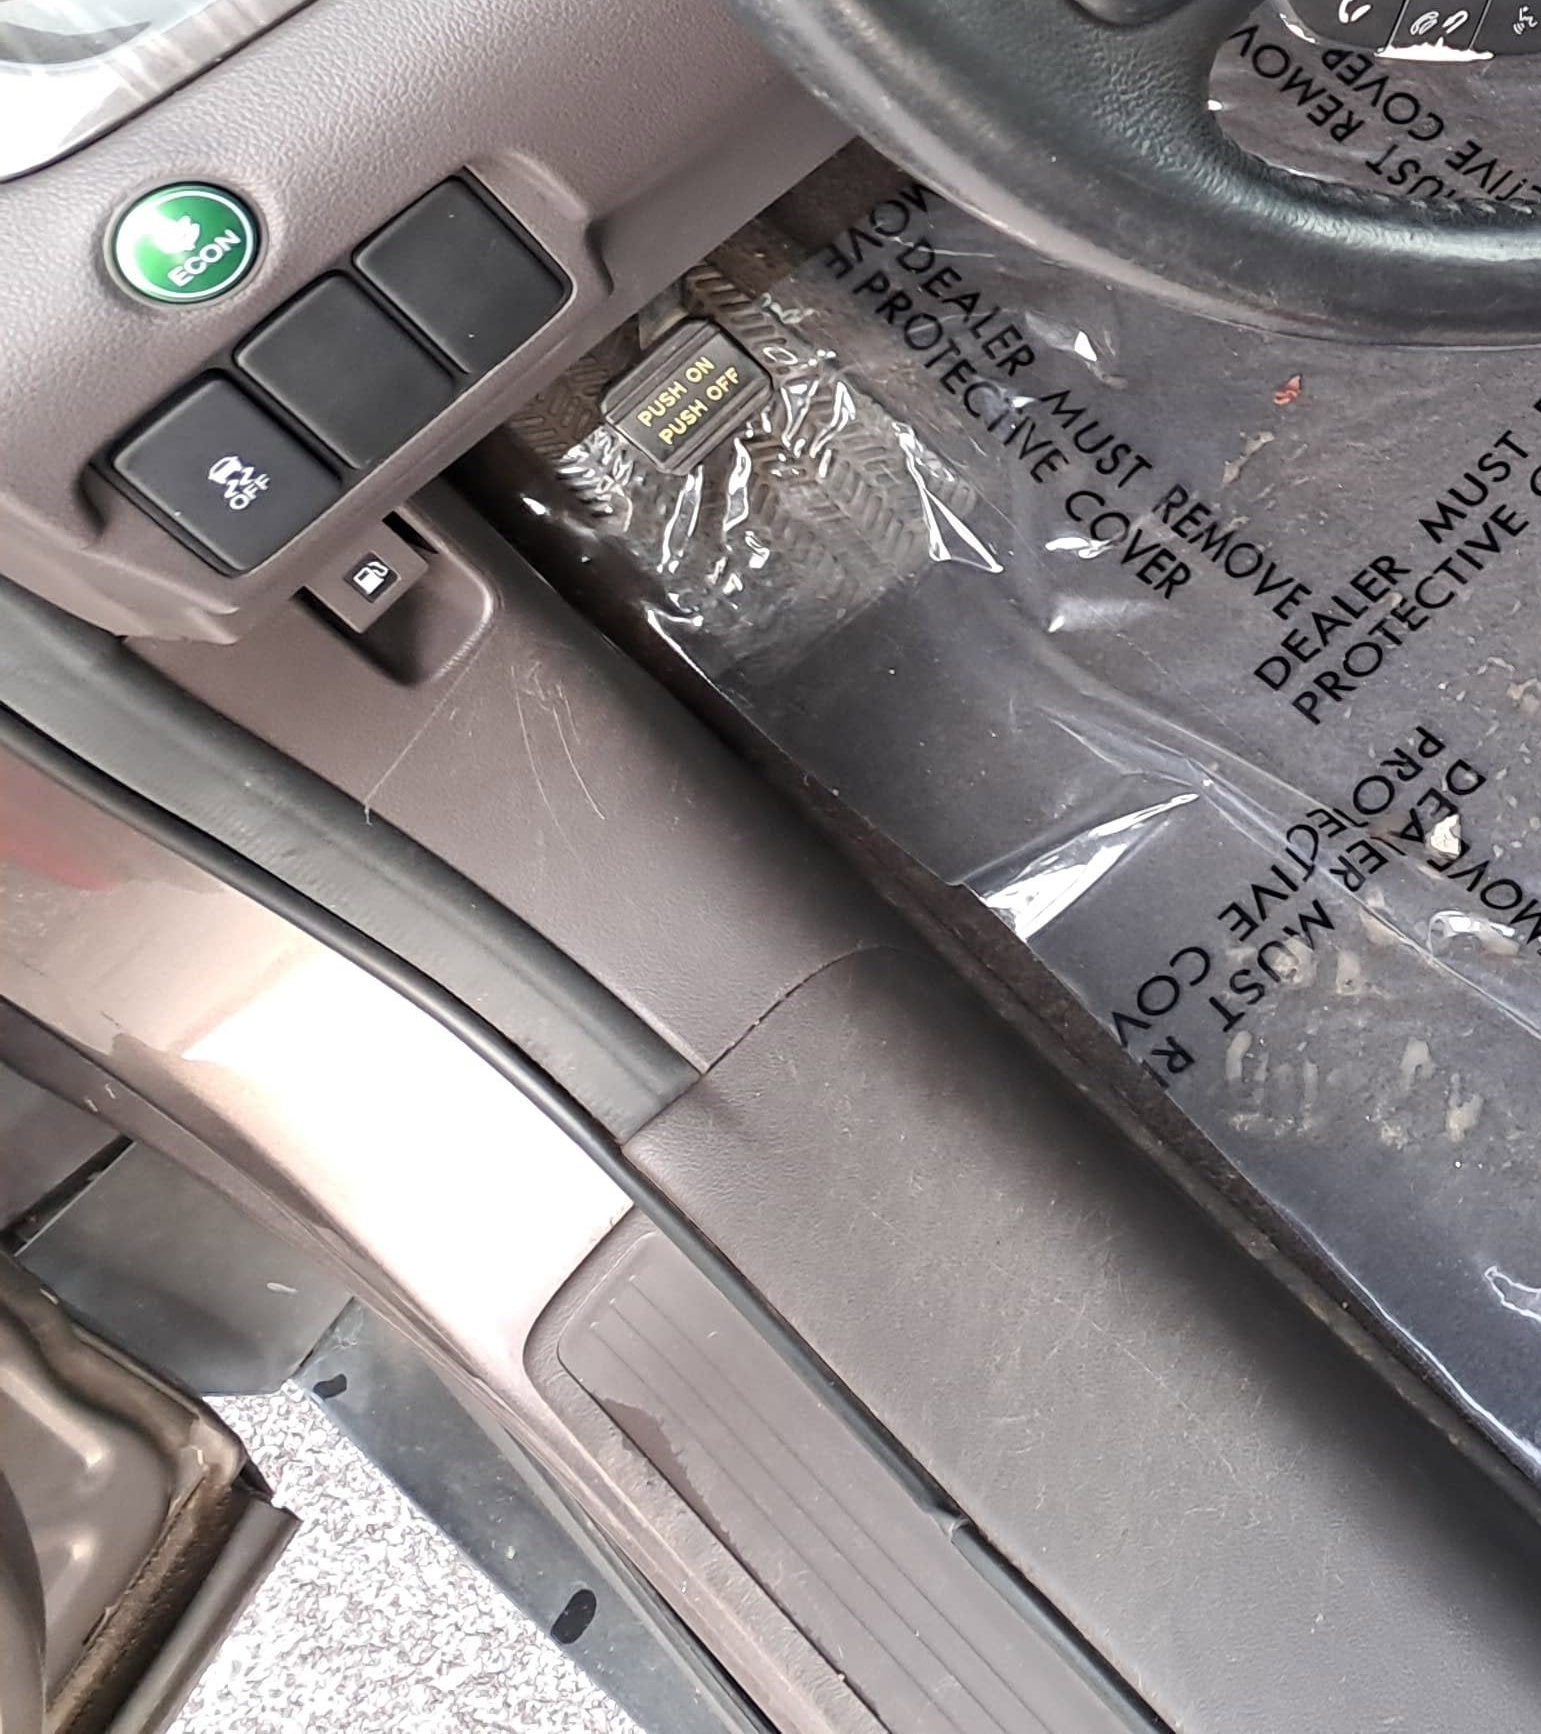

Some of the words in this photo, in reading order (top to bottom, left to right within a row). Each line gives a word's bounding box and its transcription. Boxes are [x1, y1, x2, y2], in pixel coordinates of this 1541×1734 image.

[1226, 25, 1364, 143] REMOV
[168, 229, 241, 288] ECON
[637, 381, 688, 426] PUSH
[685, 356, 715, 382] ON
[658, 399, 709, 444] PUSH
[706, 367, 739, 400] OFF
[852, 270, 1070, 483] PROTECTIVE
[1065, 491, 1191, 599] COVER
[896, 237, 1035, 376] DEALER
[1040, 390, 1152, 487] MUST
[1152, 484, 1312, 620] REMOVE
[229, 473, 270, 510] OFF
[1254, 555, 1411, 691] DEALER
[1418, 430, 1528, 544] MUST
[1292, 505, 1530, 725] PROTECTIVE
[1111, 946, 1211, 1048] COV
[1209, 900, 1335, 1032] MUST
